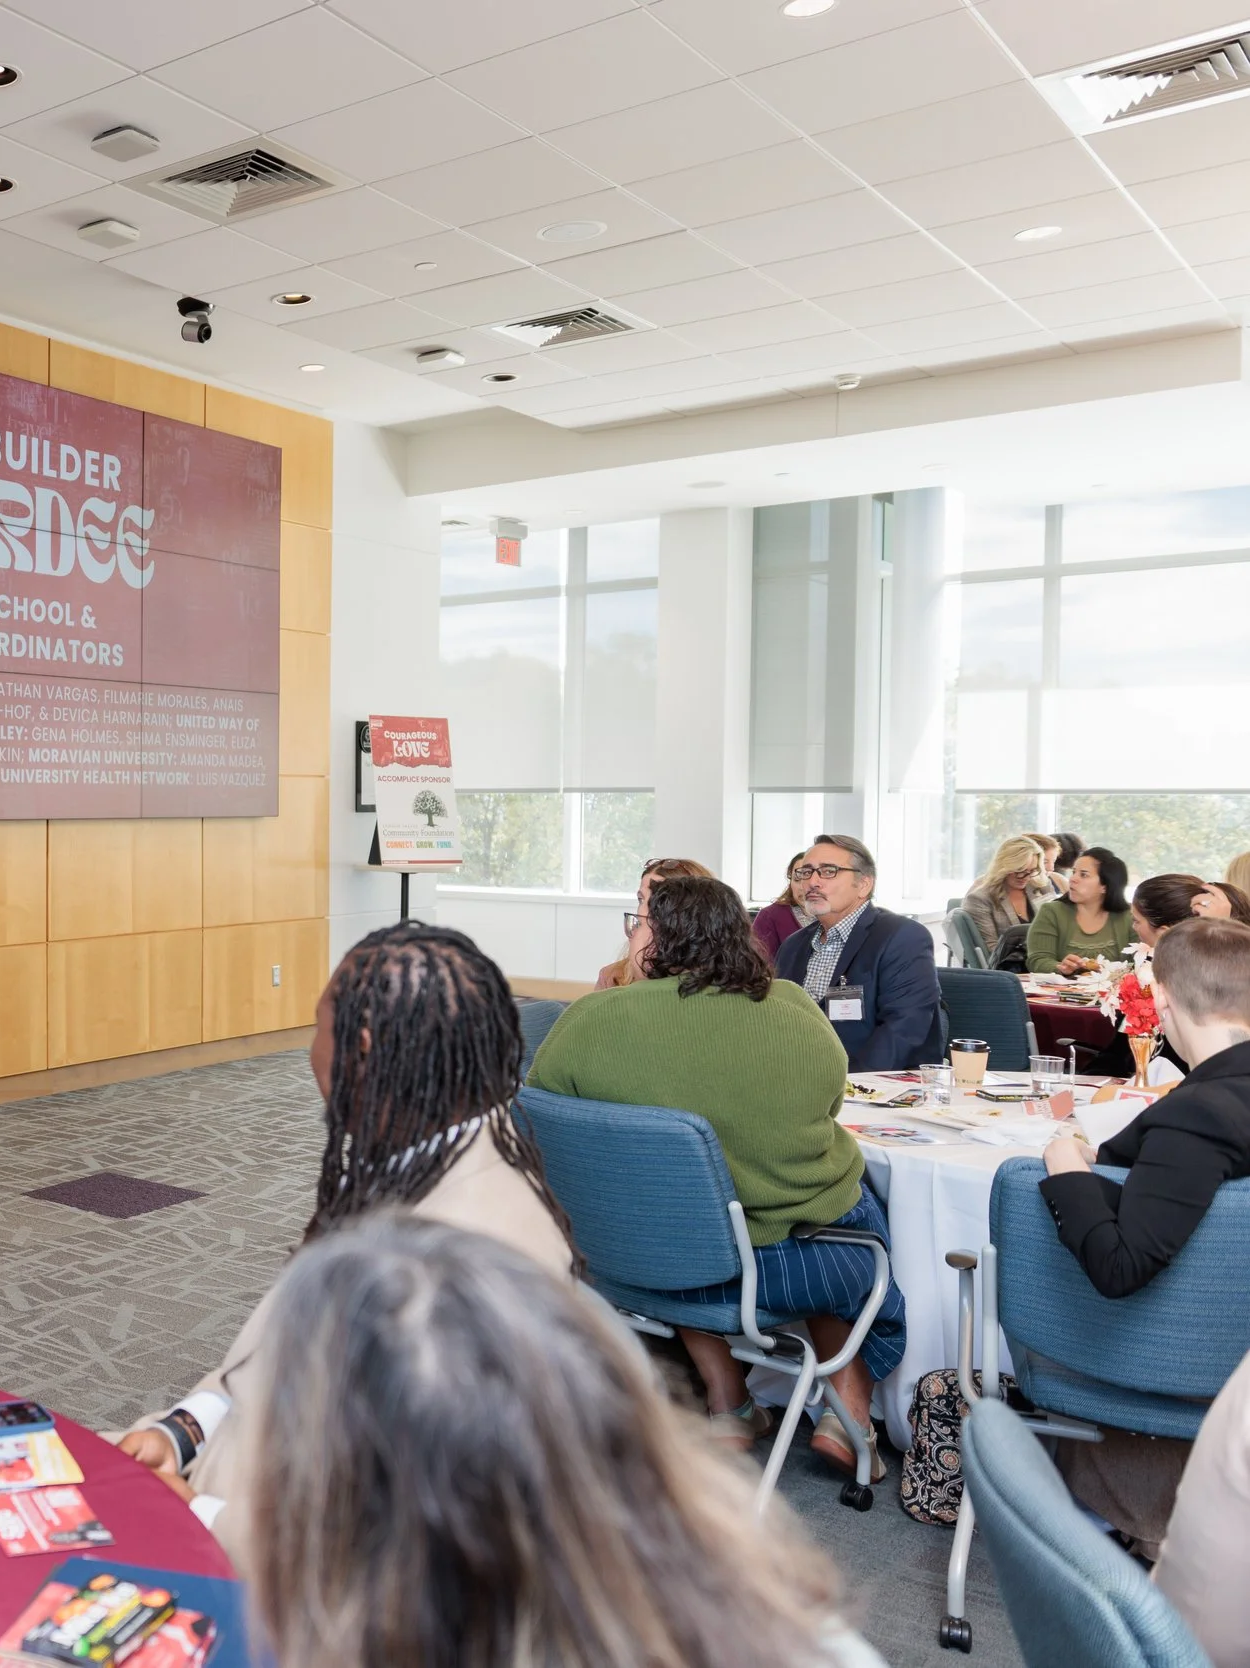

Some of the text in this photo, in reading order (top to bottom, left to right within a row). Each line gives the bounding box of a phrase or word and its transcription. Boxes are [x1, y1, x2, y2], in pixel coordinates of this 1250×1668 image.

[81, 604, 97, 630] &
[46, 685, 100, 704] VARGAS,
[157, 694, 210, 711] MORALES,
[213, 698, 244, 712] ANAIS
[39, 706, 49, 721] &
[54, 707, 98, 723] DEVICA
[176, 715, 215, 728] UNITED
[218, 717, 244, 730] WAY
[246, 718, 260, 731] OF
[31, 726, 67, 742] GENA
[71, 728, 123, 744] HOLMES,
[126, 731, 161, 745] SHIMA
[166, 733, 228, 750] ENSMINGER,
[383, 730, 438, 741] COURAGEOUS
[29, 748, 100, 764] MORAVIAN
[104, 751, 177, 766] UNIVERSITY:
[180, 754, 226, 767] AMANDA
[393, 740, 431, 758] LOVE
[1, 768, 79, 783] UNIVERSITY
[83, 770, 130, 784] HEALTH
[134, 771, 193, 785] NETWORK:
[196, 772, 218, 786] LUIS
[221, 773, 266, 787] VAZQUEZ
[377, 775, 451, 784] ACCOMPLICE SPONSOR
